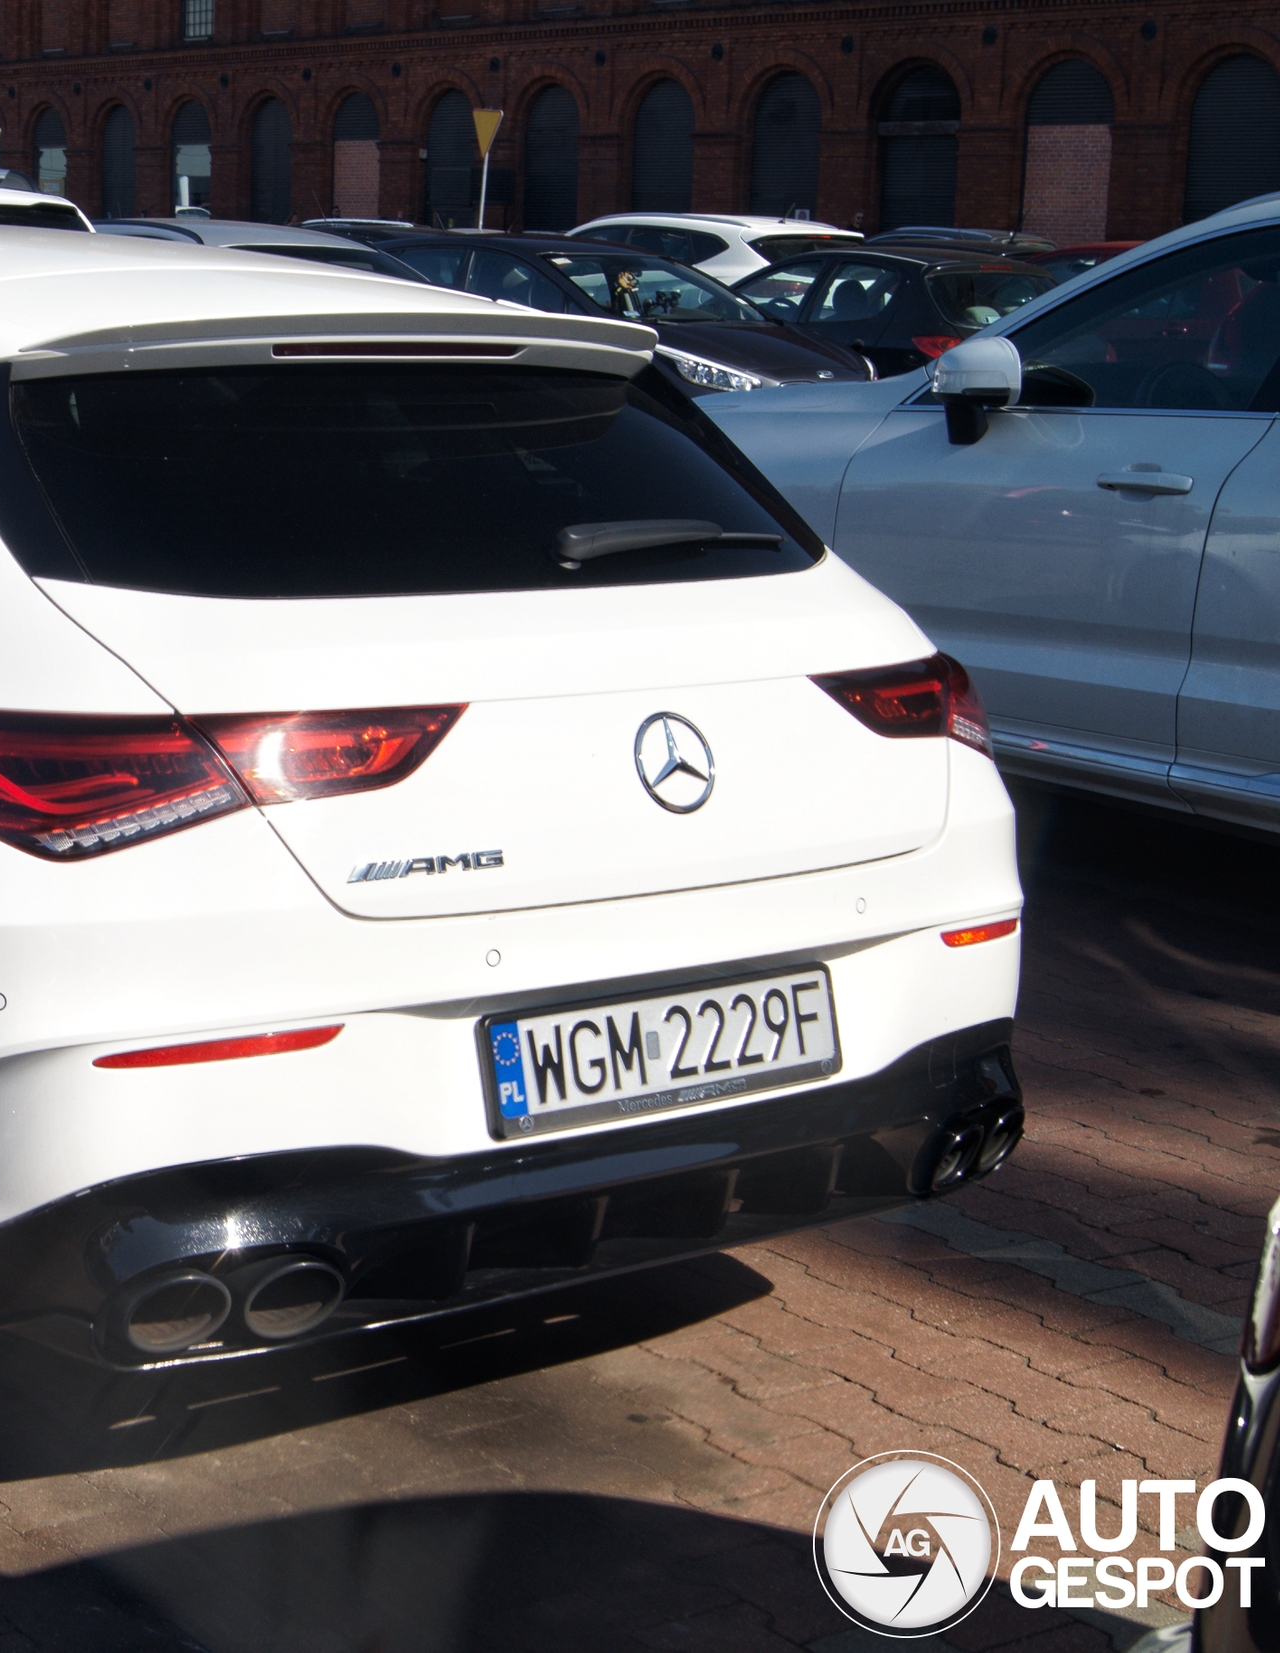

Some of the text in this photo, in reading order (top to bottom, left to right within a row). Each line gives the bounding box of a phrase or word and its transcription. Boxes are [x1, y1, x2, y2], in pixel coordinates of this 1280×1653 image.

[526, 980, 821, 1105] WGM 2229F
[498, 1080, 525, 1105] PL
[617, 1093, 673, 1113] Mercedes
